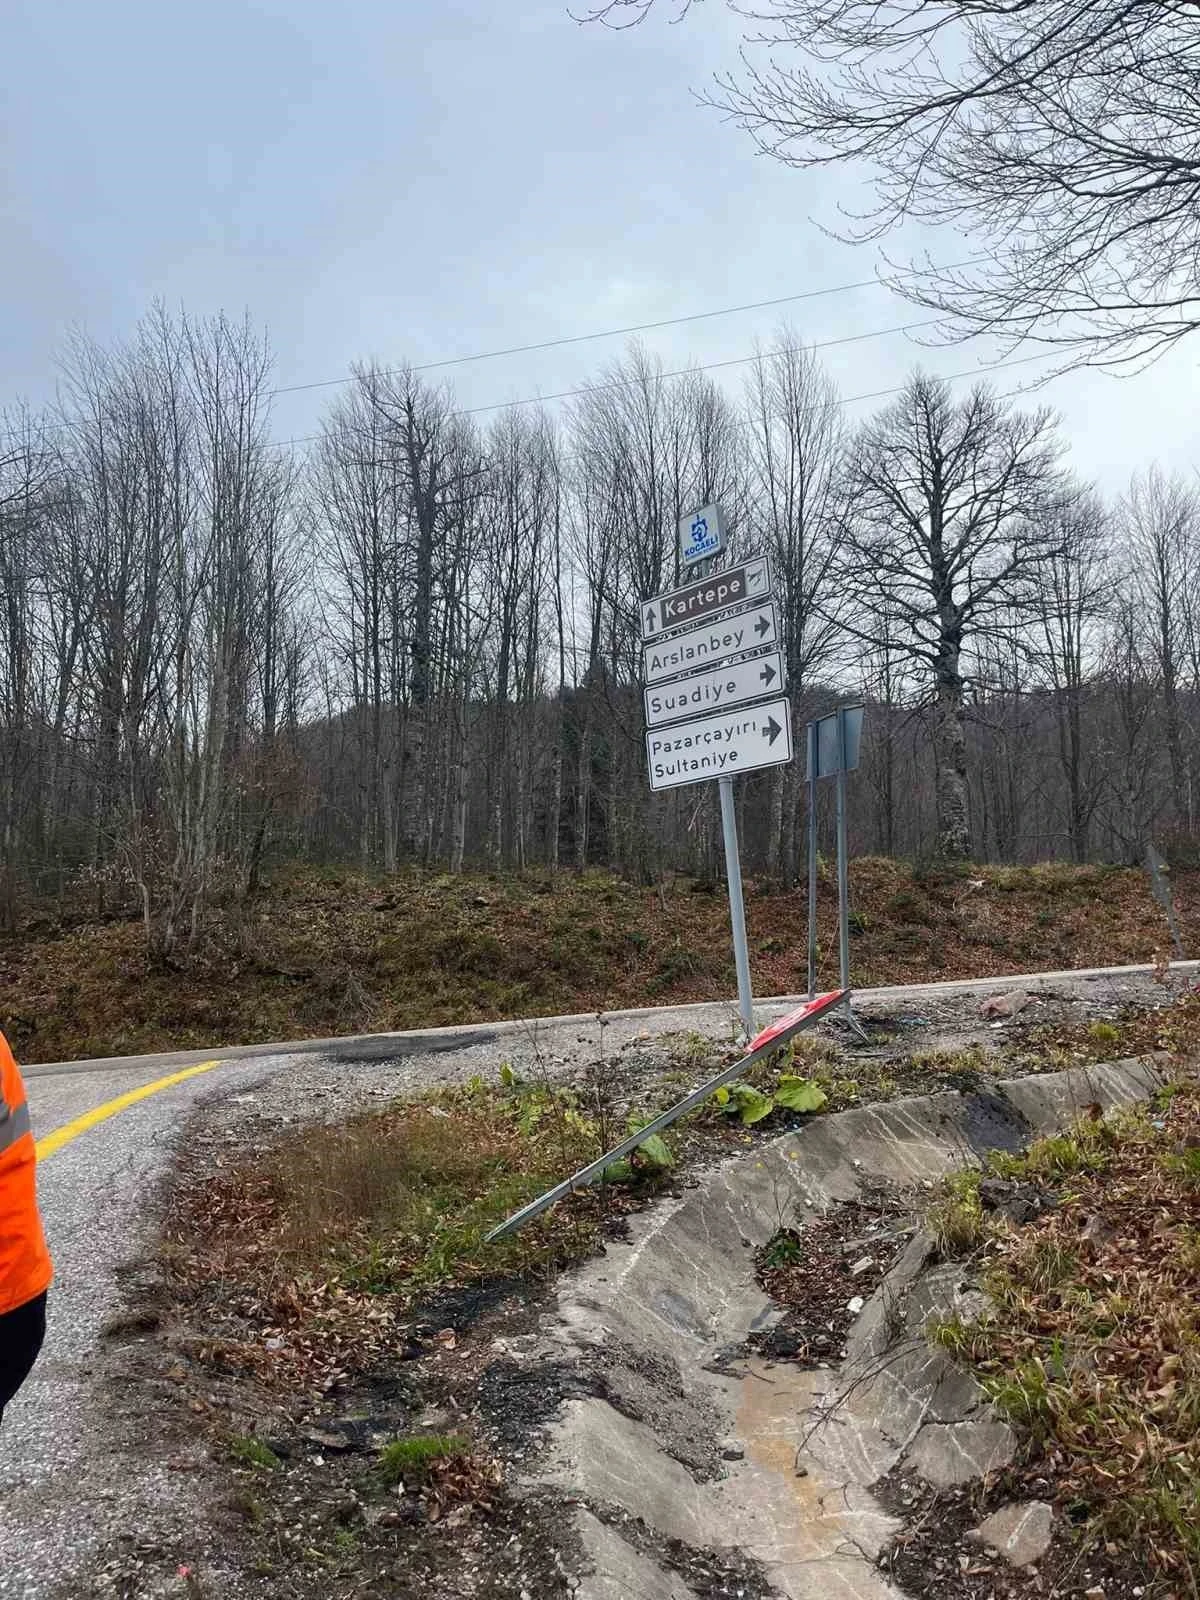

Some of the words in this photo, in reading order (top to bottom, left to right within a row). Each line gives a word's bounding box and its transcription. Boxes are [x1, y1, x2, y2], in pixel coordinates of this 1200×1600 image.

[665, 577, 742, 619] Kartepe
[650, 628, 744, 672] Arslanbey
[651, 679, 737, 713] Suadiye
[652, 720, 757, 756] Pazarçayırı
[655, 749, 738, 778] Sultaniye
